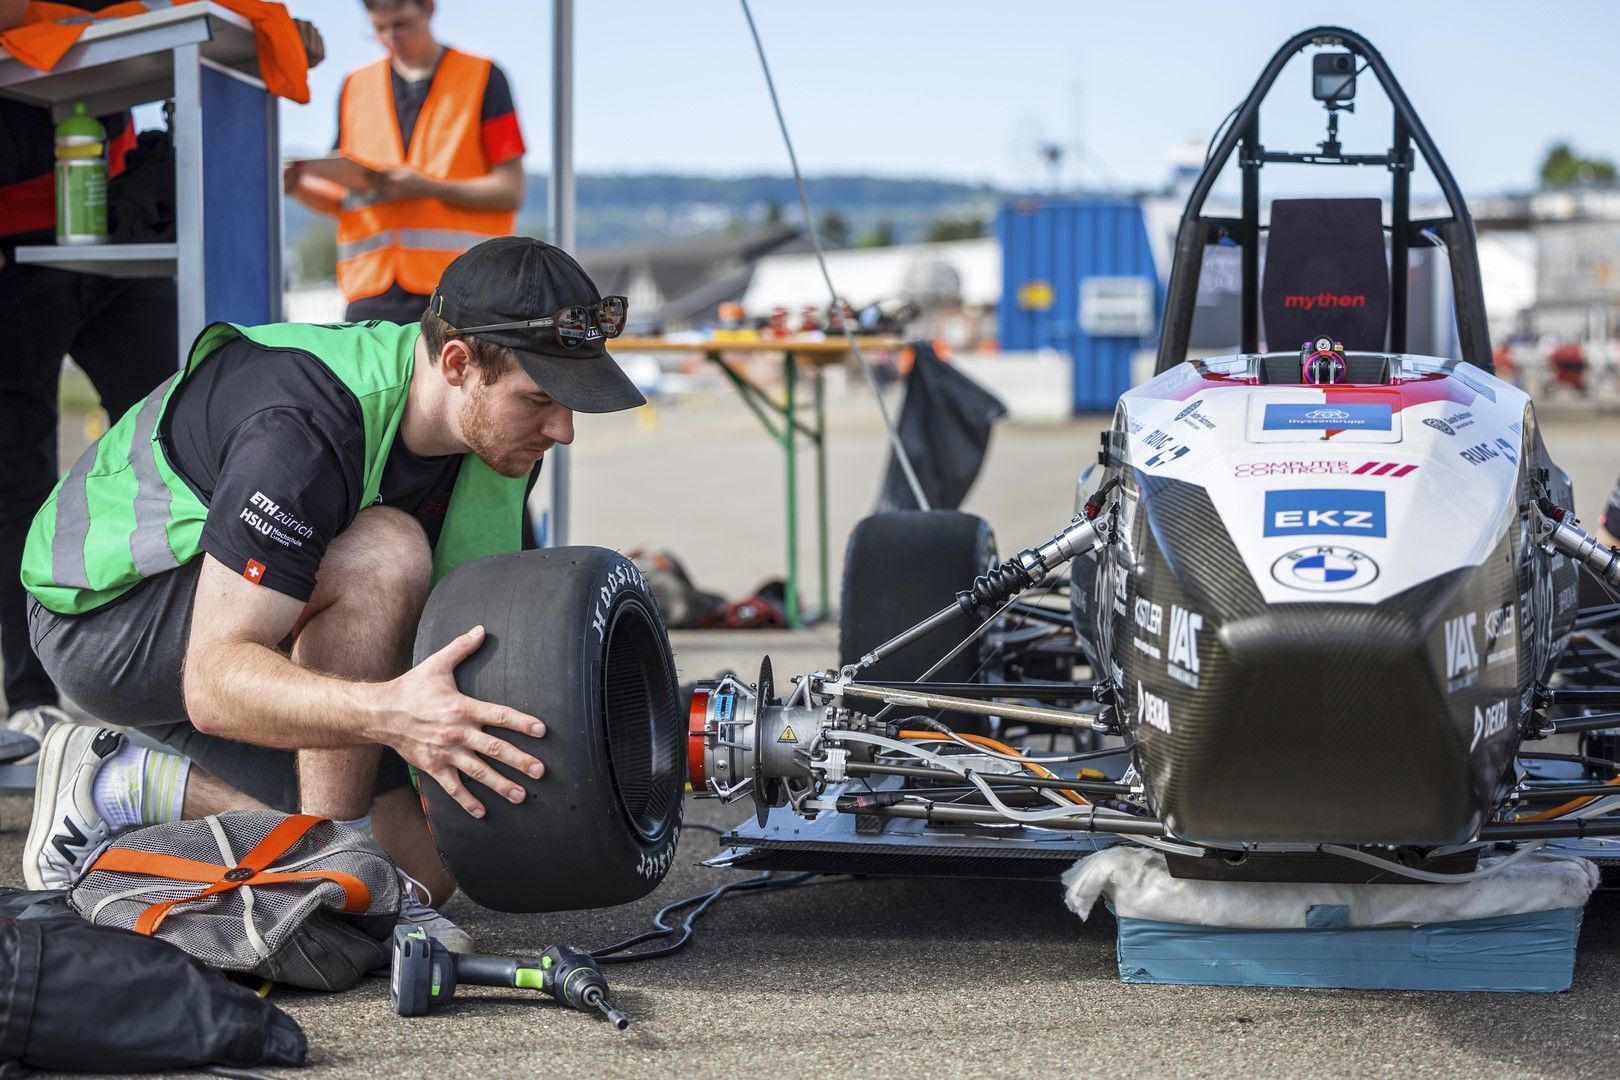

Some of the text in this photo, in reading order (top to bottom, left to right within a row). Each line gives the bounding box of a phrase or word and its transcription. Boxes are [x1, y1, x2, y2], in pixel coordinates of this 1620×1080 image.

[1284, 292, 1366, 310] mythen
[1288, 418, 1365, 426] thyssenkrupp
[1142, 429, 1174, 450] RUAC
[1459, 443, 1500, 466] RUAC
[1234, 460, 1349, 472] COMPUTER
[1234, 467, 1350, 478] CONTROLS
[239, 507, 273, 535] HSLU
[1274, 510, 1373, 528] EKZ
[269, 532, 290, 547] Luzern
[272, 527, 303, 547] Hochschule
[1287, 547, 1364, 561] BMW
[592, 563, 645, 644] Hoosier
[1484, 698, 1508, 738] DEKRA
